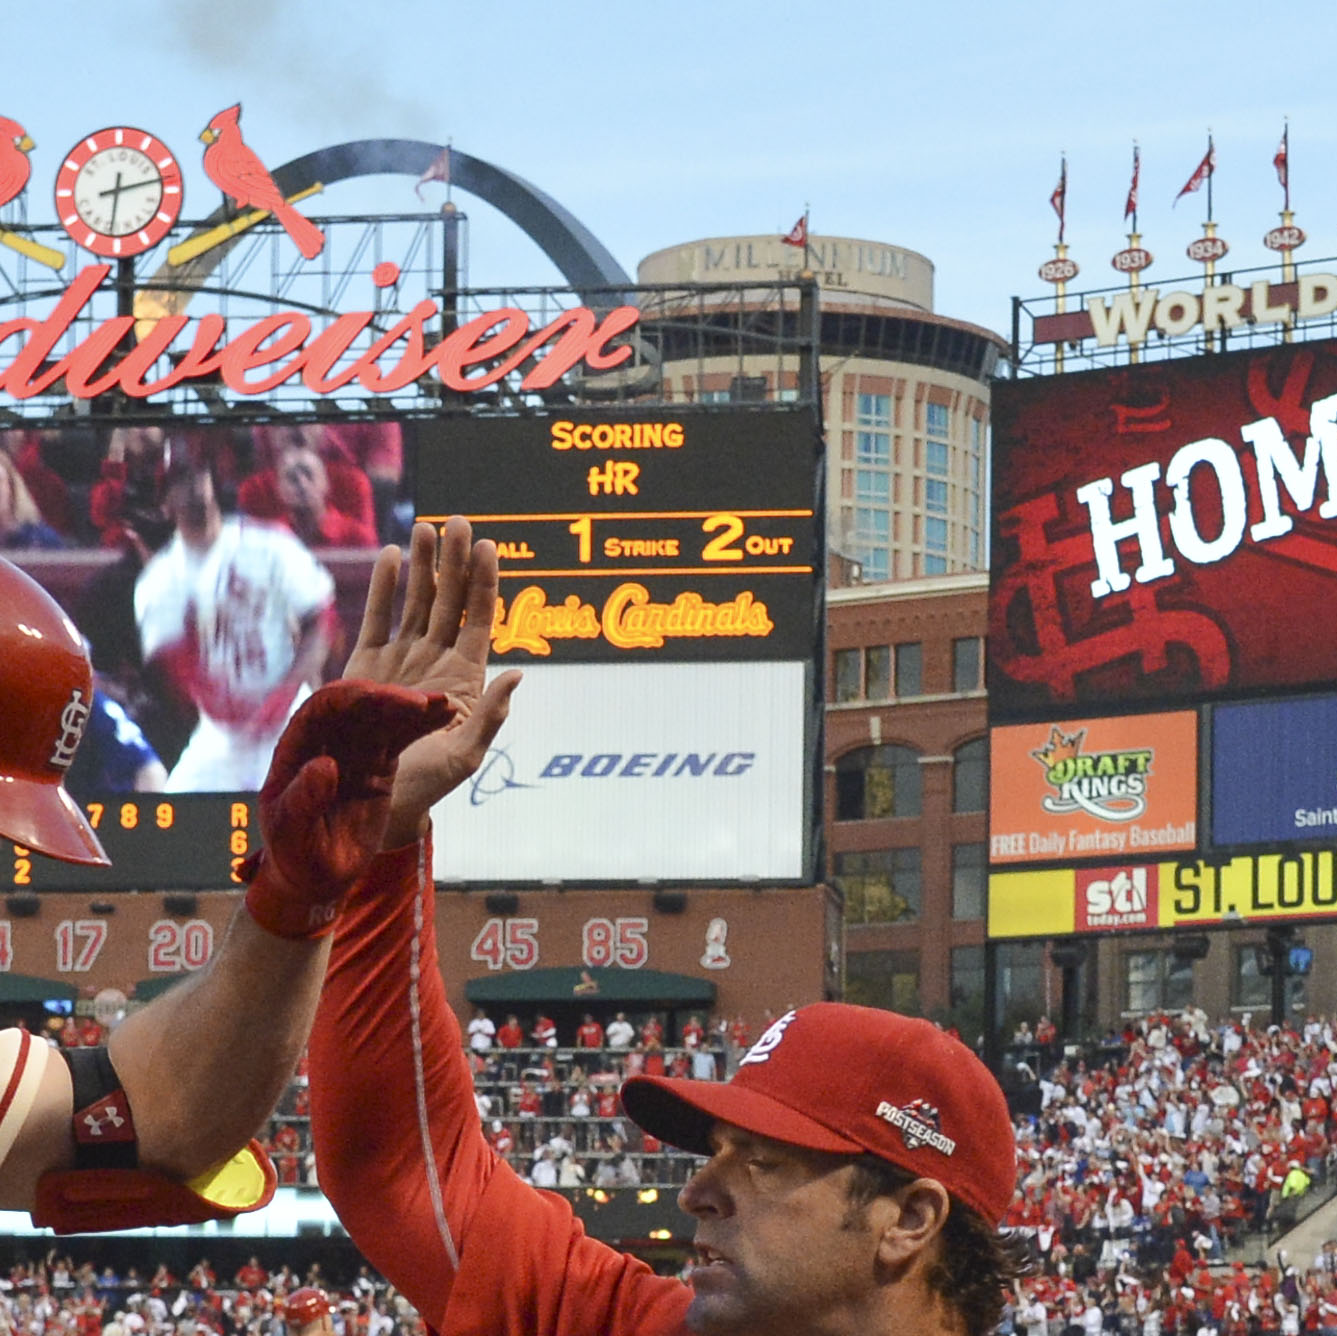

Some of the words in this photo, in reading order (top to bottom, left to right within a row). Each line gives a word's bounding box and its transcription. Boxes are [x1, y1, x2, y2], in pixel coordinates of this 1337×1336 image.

[1190, 240, 1225, 260] 1934
[1266, 228, 1302, 248] 1942
[1040, 262, 1077, 280] 1926
[1114, 251, 1148, 270] 1931
[551, 420, 684, 451] SCORING
[587, 460, 641, 496] HR
[494, 538, 536, 560] ALL
[568, 516, 594, 564] 1
[604, 537, 681, 558] STRIKE
[701, 513, 746, 562] 2
[744, 535, 795, 556] OUT
[603, 581, 775, 649] Cardinals
[538, 752, 757, 779] BOEING
[1047, 750, 1152, 785] DRAFT
[1060, 774, 1146, 802] KINGS
[86, 802, 105, 829] 7
[120, 802, 140, 829] 8
[155, 802, 175, 829] 9
[230, 802, 249, 829] R
[230, 830, 249, 855] 6
[990, 832, 1027, 858] FREE
[1029, 831, 1066, 857] Daily
[1068, 829, 1127, 852] Fantasy
[1129, 821, 1196, 847] Baseball
[13, 858, 32, 885] 2
[1174, 857, 1236, 915] ST.
[1086, 867, 1148, 916] stl
[55, 919, 108, 973] 17
[149, 919, 213, 973] 20
[471, 917, 540, 971] 45
[581, 917, 649, 971] 85
[875, 1100, 957, 1157] POSTSEASON
